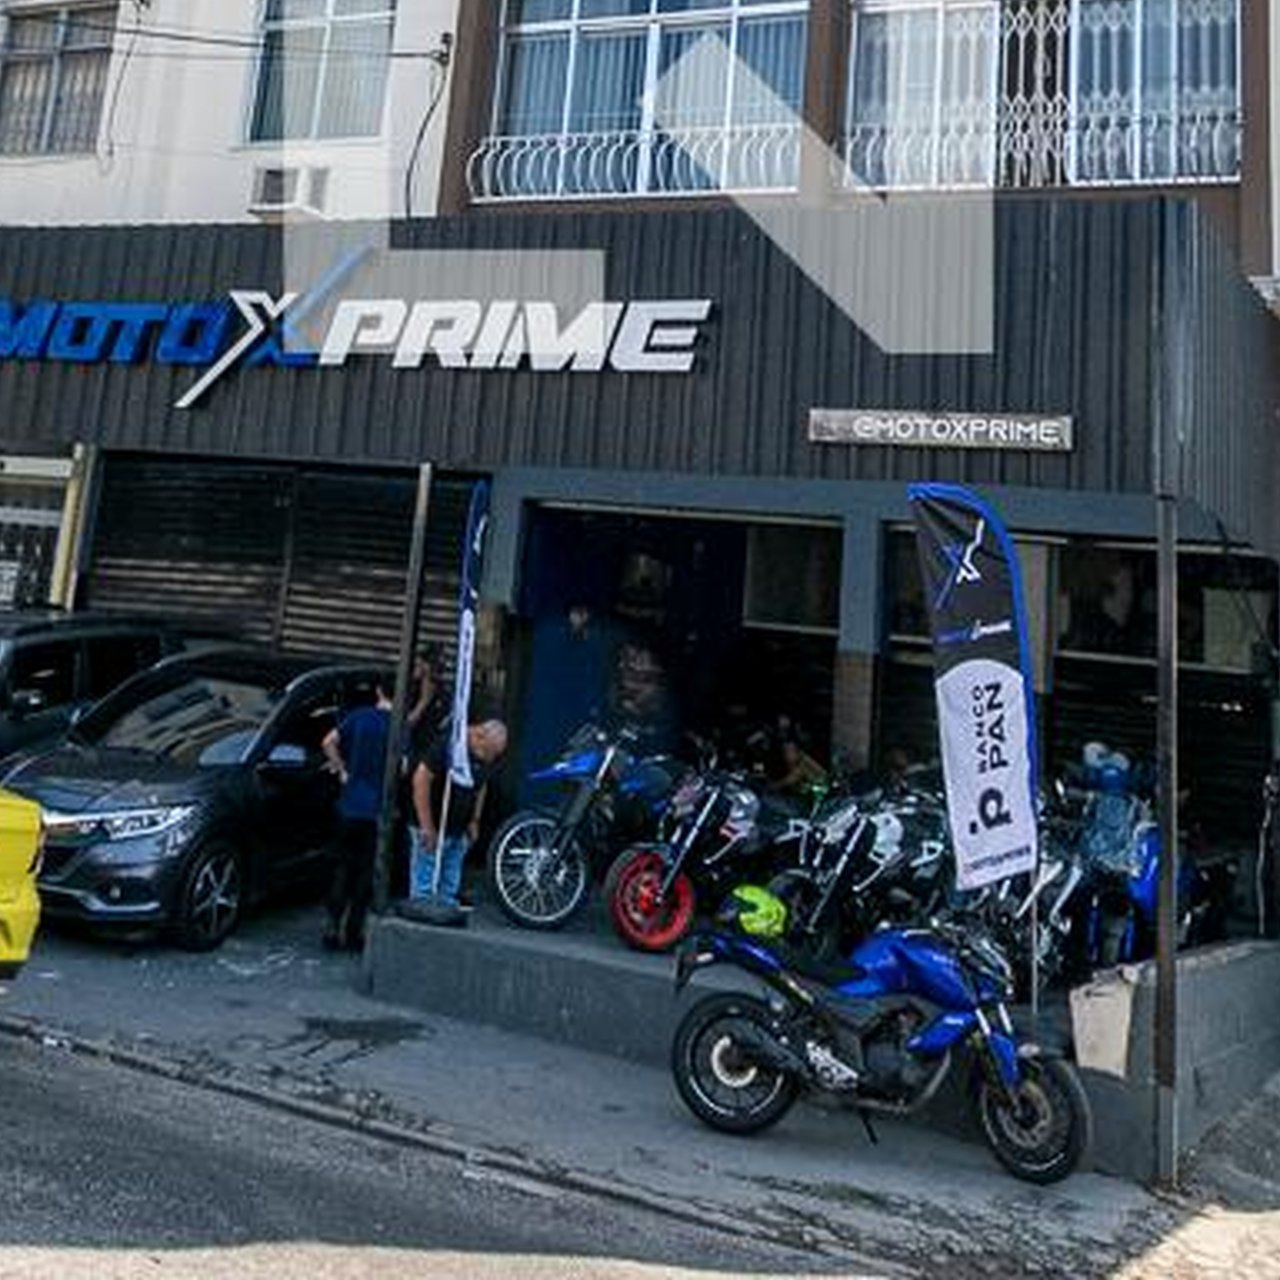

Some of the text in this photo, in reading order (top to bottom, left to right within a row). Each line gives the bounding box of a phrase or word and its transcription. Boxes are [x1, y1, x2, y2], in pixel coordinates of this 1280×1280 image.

[319, 299, 712, 373] PRIME
[853, 416, 1061, 443] @MOTOXPRIME
[983, 681, 1010, 771] PAN
